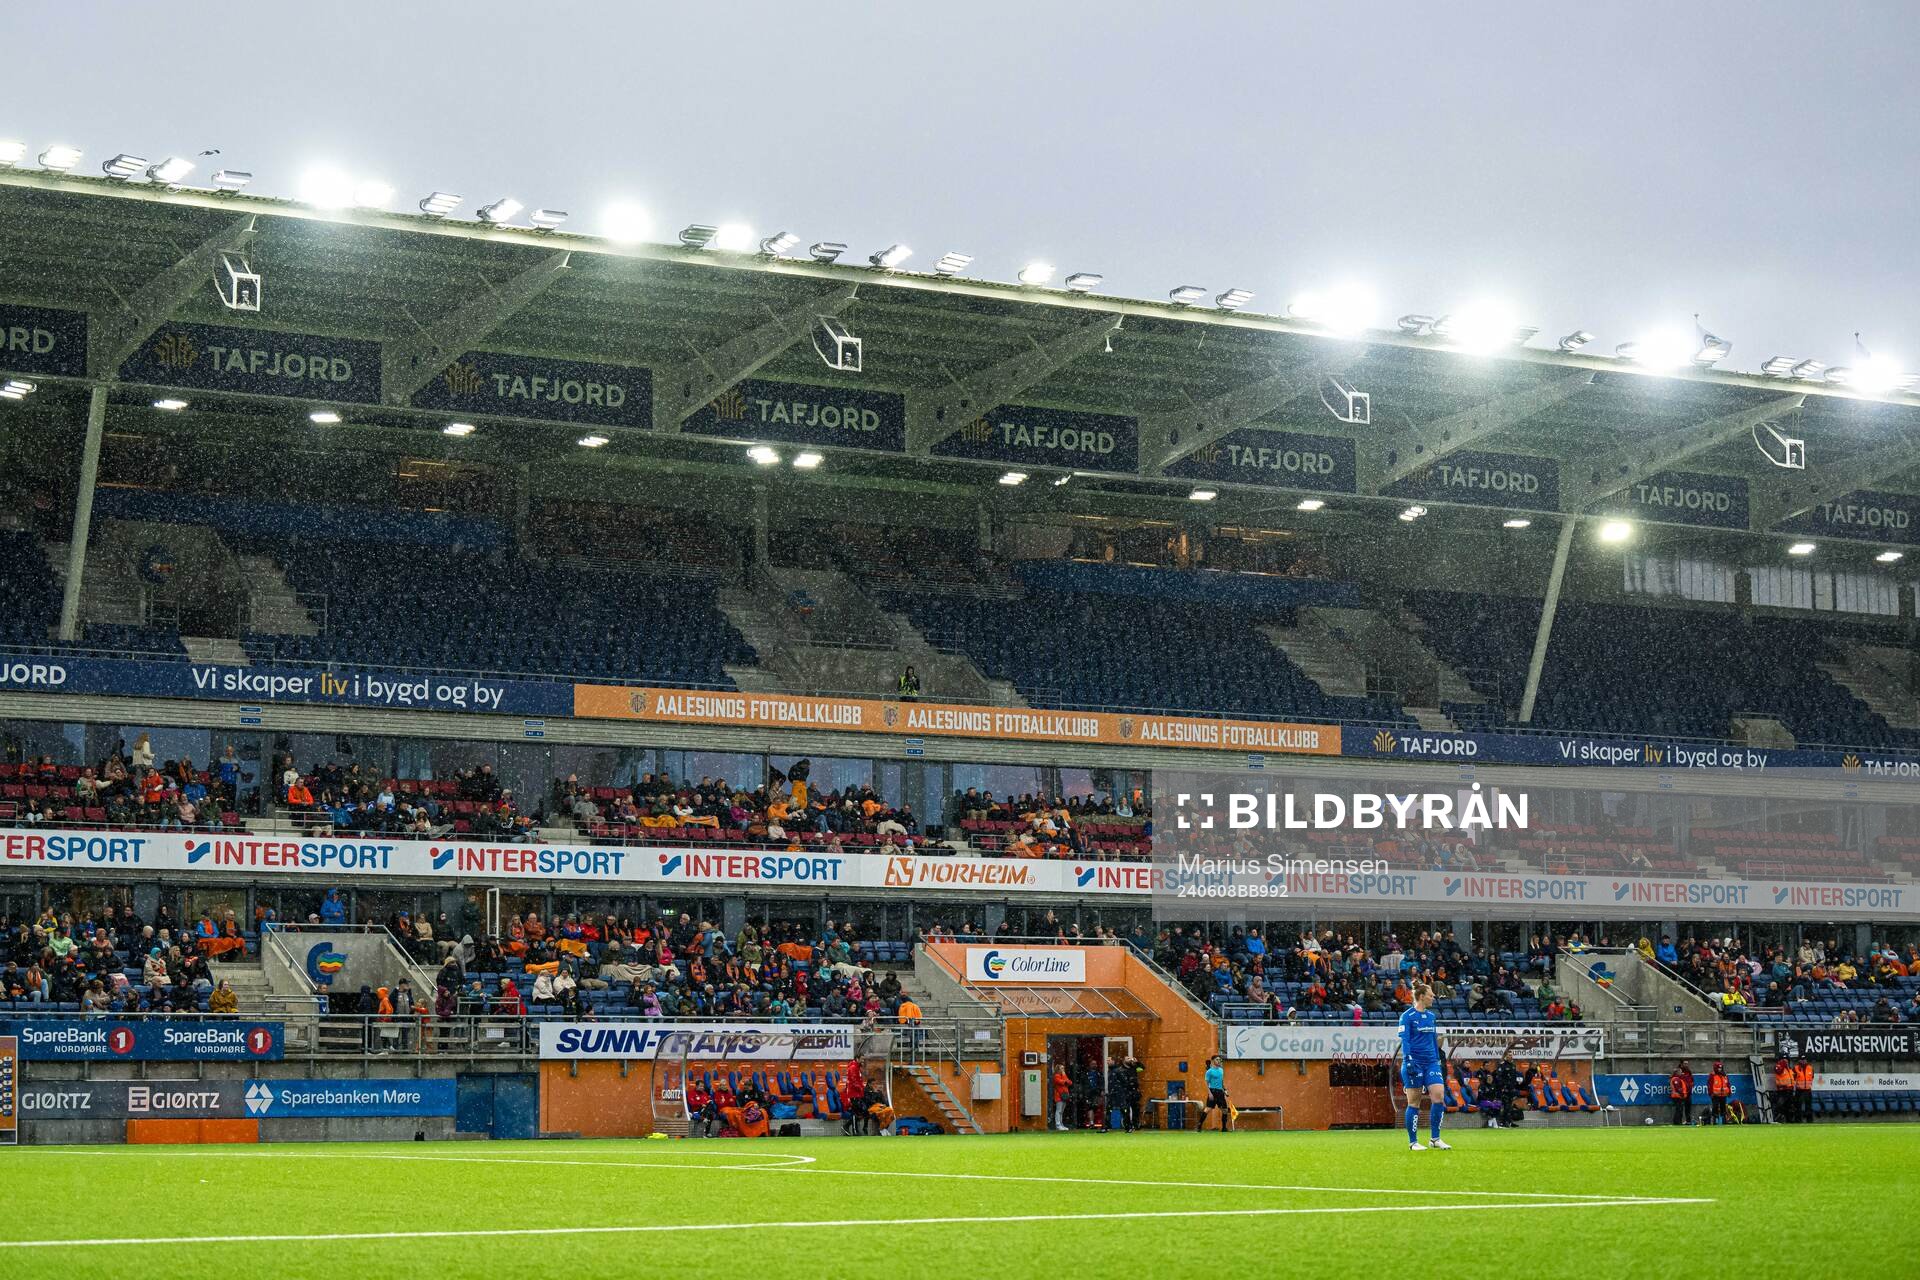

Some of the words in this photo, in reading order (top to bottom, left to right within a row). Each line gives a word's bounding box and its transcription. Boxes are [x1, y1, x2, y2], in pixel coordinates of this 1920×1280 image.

[0, 326, 55, 353] RD
[208, 345, 353, 382] TAFJORD
[492, 373, 625, 408] TAFJORD
[755, 399, 880, 432] TAFJORD
[1000, 422, 1115, 454] TAFJORD
[1227, 444, 1335, 474] TAFJORD
[1438, 465, 1540, 494] TAFJORD
[1636, 484, 1730, 512] TAFJORD
[1822, 503, 1910, 529] TAFJORD
[0, 664, 66, 684] JORD
[192, 668, 216, 690] Vi
[224, 668, 312, 698] skaper
[321, 672, 348, 696] liv
[354, 675, 360, 696] i
[367, 676, 429, 705] bygd
[436, 685, 467, 707] og
[474, 682, 504, 709] by
[656, 695, 746, 720] AALESUNDS
[750, 699, 862, 725] FOTBALLKLUBB
[907, 708, 991, 732] AALESUNDS
[996, 714, 1099, 738] FOTBALLKLUBB
[1140, 721, 1218, 744] AALESUNDS
[1222, 725, 1319, 750] FOTBALLKLUBB
[1400, 737, 1478, 756] TAFJORD
[1559, 741, 1576, 758] Vi
[1580, 742, 1640, 764] skaper
[1644, 745, 1663, 763] liv
[1667, 746, 1671, 764] i
[1675, 747, 1718, 769] bygd
[1722, 752, 1743, 770] og
[1746, 750, 1768, 771] by
[0, 834, 146, 863] ERSPORT
[214, 840, 394, 868] INTERSPORT
[458, 847, 625, 875] INTERSPORT
[685, 854, 842, 881] INTERSPORT
[919, 862, 1029, 885] NORHEIM
[1286, 872, 1416, 896] INTERSPORT
[1464, 876, 1588, 900] INTERSPORT
[1632, 882, 1748, 905] INTERSPORT
[1790, 886, 1902, 908] INTERSPORT
[22, 1028, 106, 1044] SpareBank
[116, 1032, 126, 1048] 1
[164, 1028, 245, 1045] SpareBank
[254, 1032, 264, 1049] 1
[1260, 1032, 1324, 1052] Ocean
[1805, 1036, 1909, 1053] ASFALTSERVICE
[22, 1091, 91, 1110] GIØRTZ
[152, 1091, 220, 1110] GIØRTZ
[281, 1088, 379, 1108] Sparebanken
[383, 1088, 421, 1104] Møre
